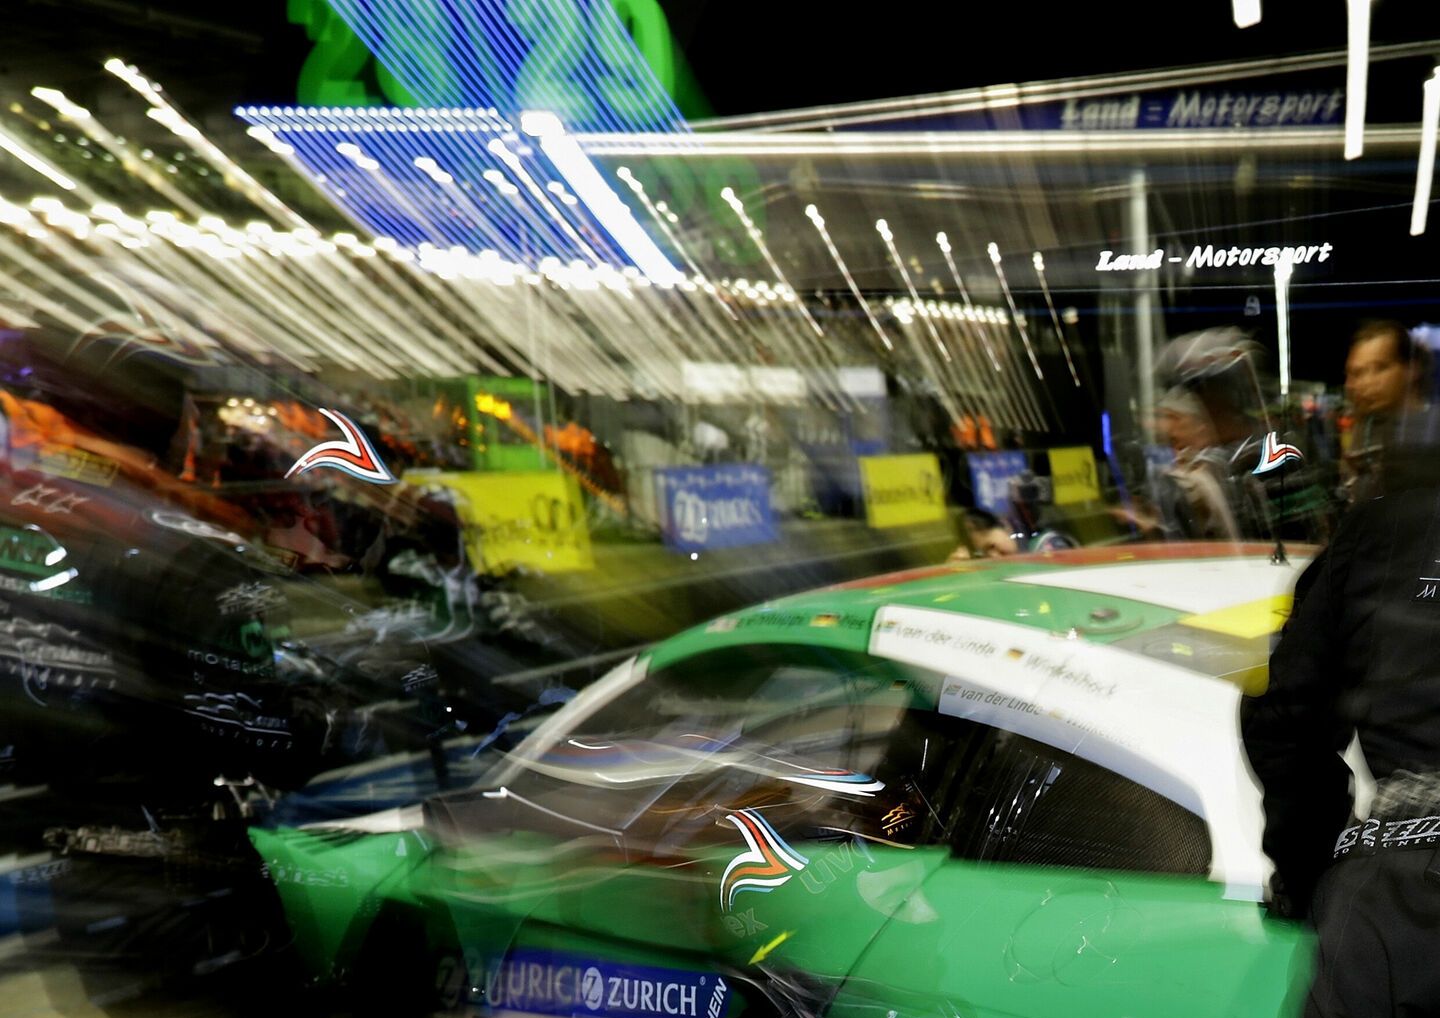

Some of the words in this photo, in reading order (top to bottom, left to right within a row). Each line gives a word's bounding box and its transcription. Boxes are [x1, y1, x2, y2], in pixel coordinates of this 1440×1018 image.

[1096, 249, 1164, 271] Land
[1186, 242, 1333, 272] Motorsport
[960, 687, 984, 702] van
[984, 690, 1009, 706] der
[608, 977, 698, 1017] ZURICH
